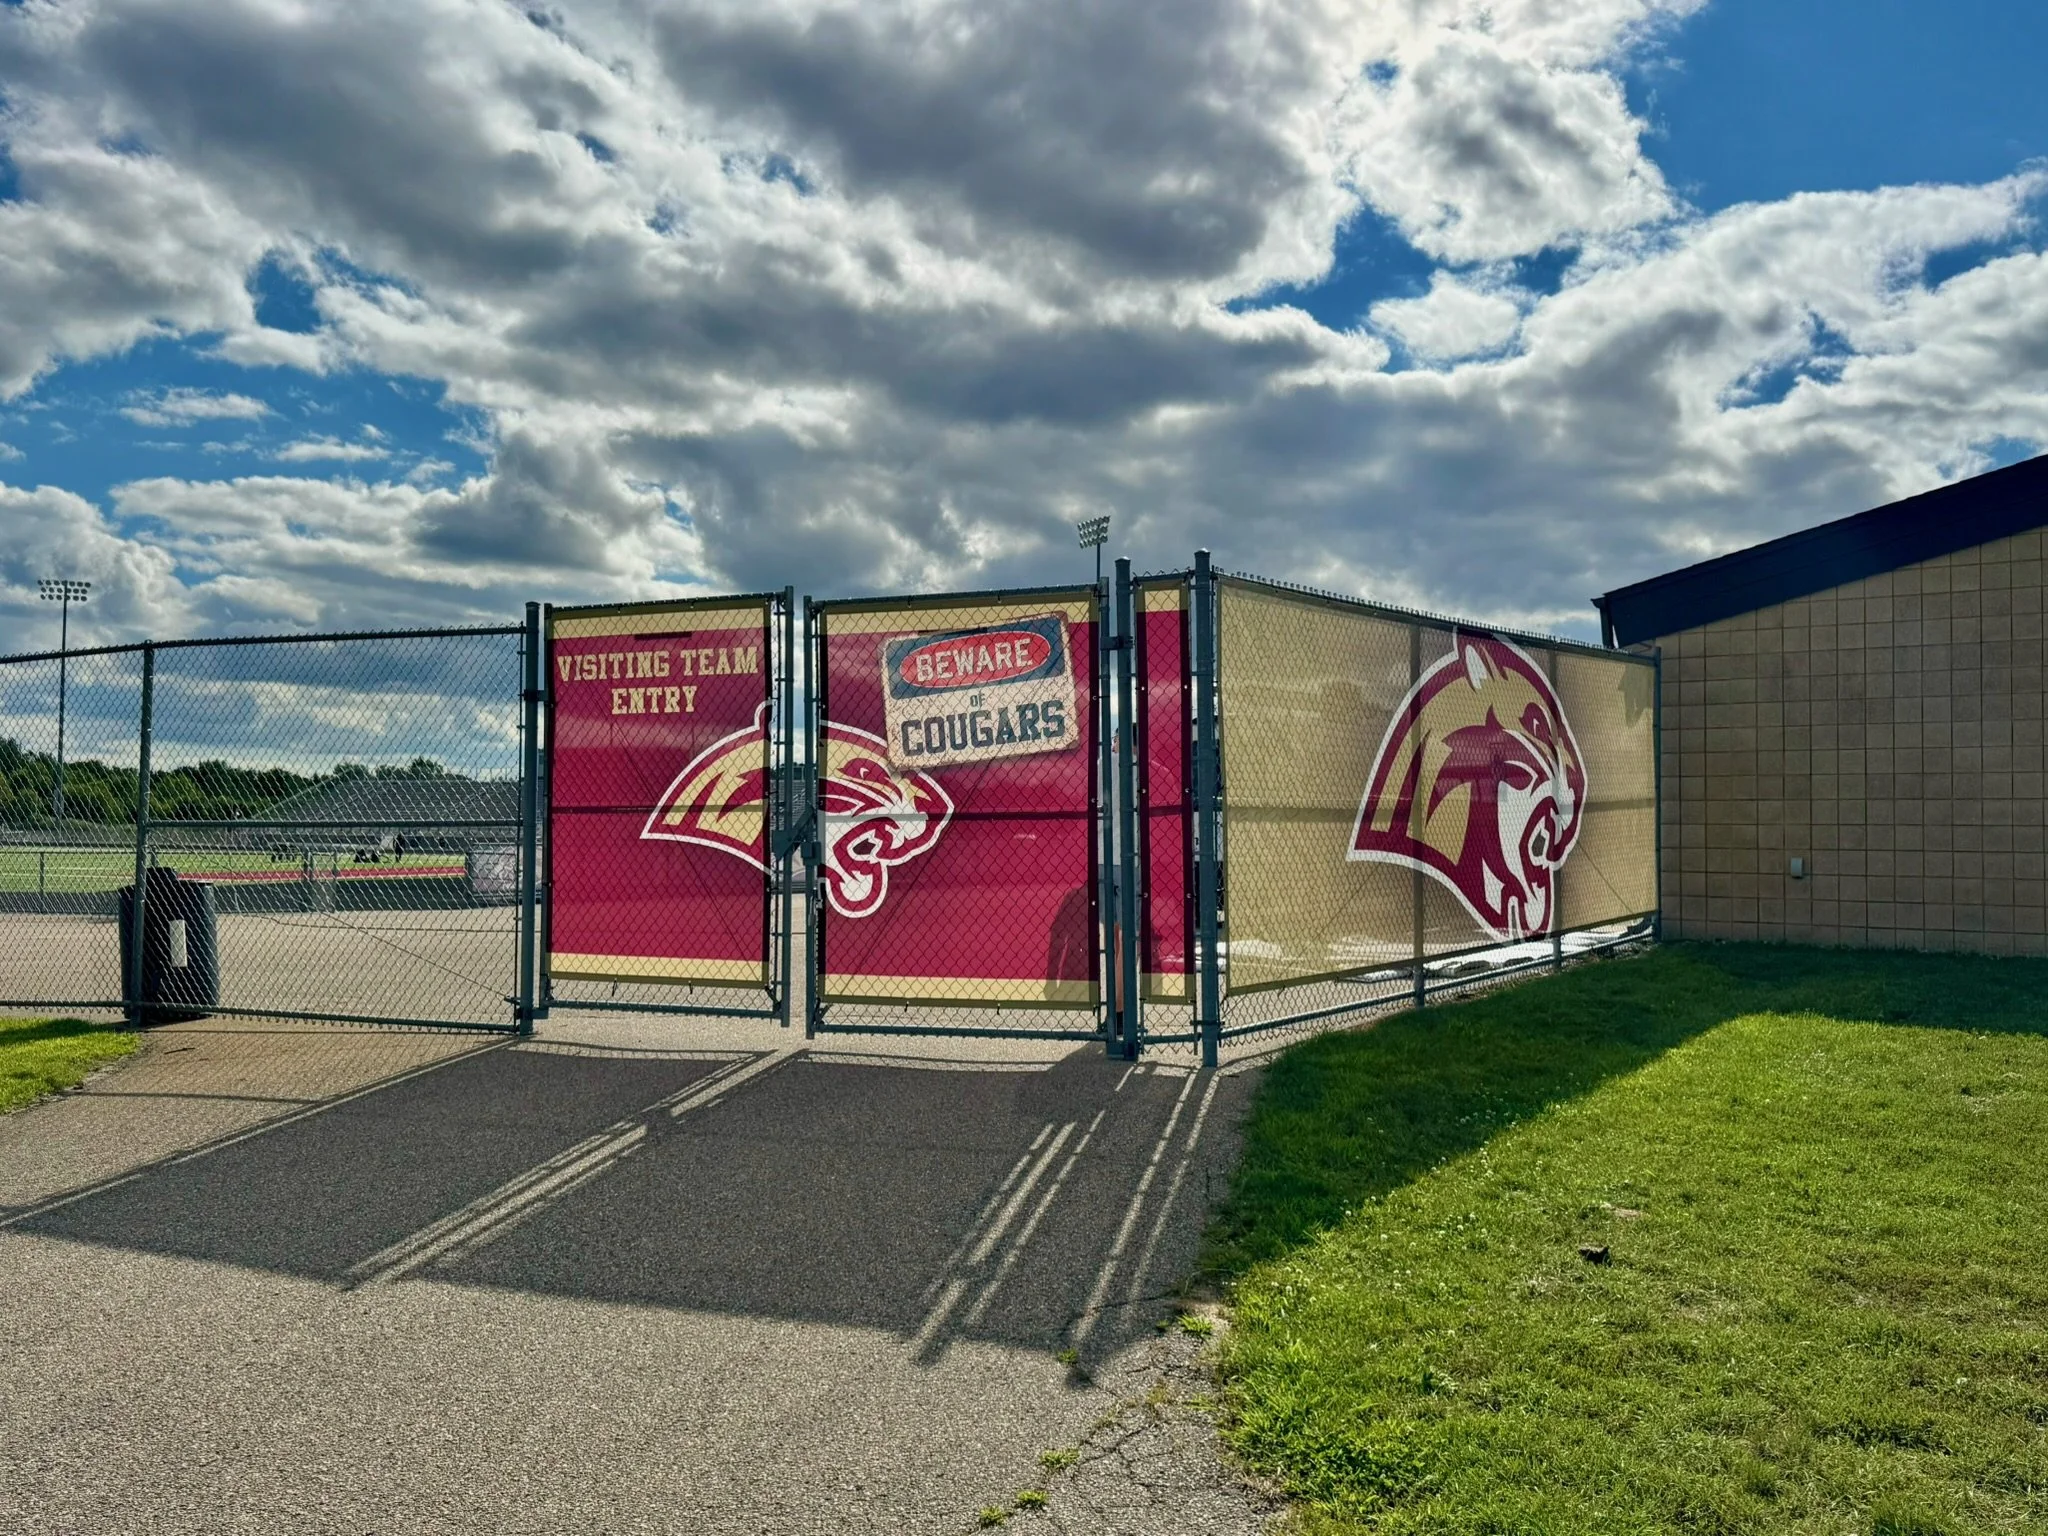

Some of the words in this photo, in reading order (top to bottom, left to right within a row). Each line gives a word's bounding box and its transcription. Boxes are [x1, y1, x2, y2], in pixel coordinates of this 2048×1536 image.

[557, 651, 670, 682] VISITING
[680, 646, 759, 676] TEAM
[916, 638, 1033, 682] BEWARE
[611, 685, 698, 715] ENTRY
[969, 692, 985, 708] OF
[900, 699, 1066, 757] COUGARS
